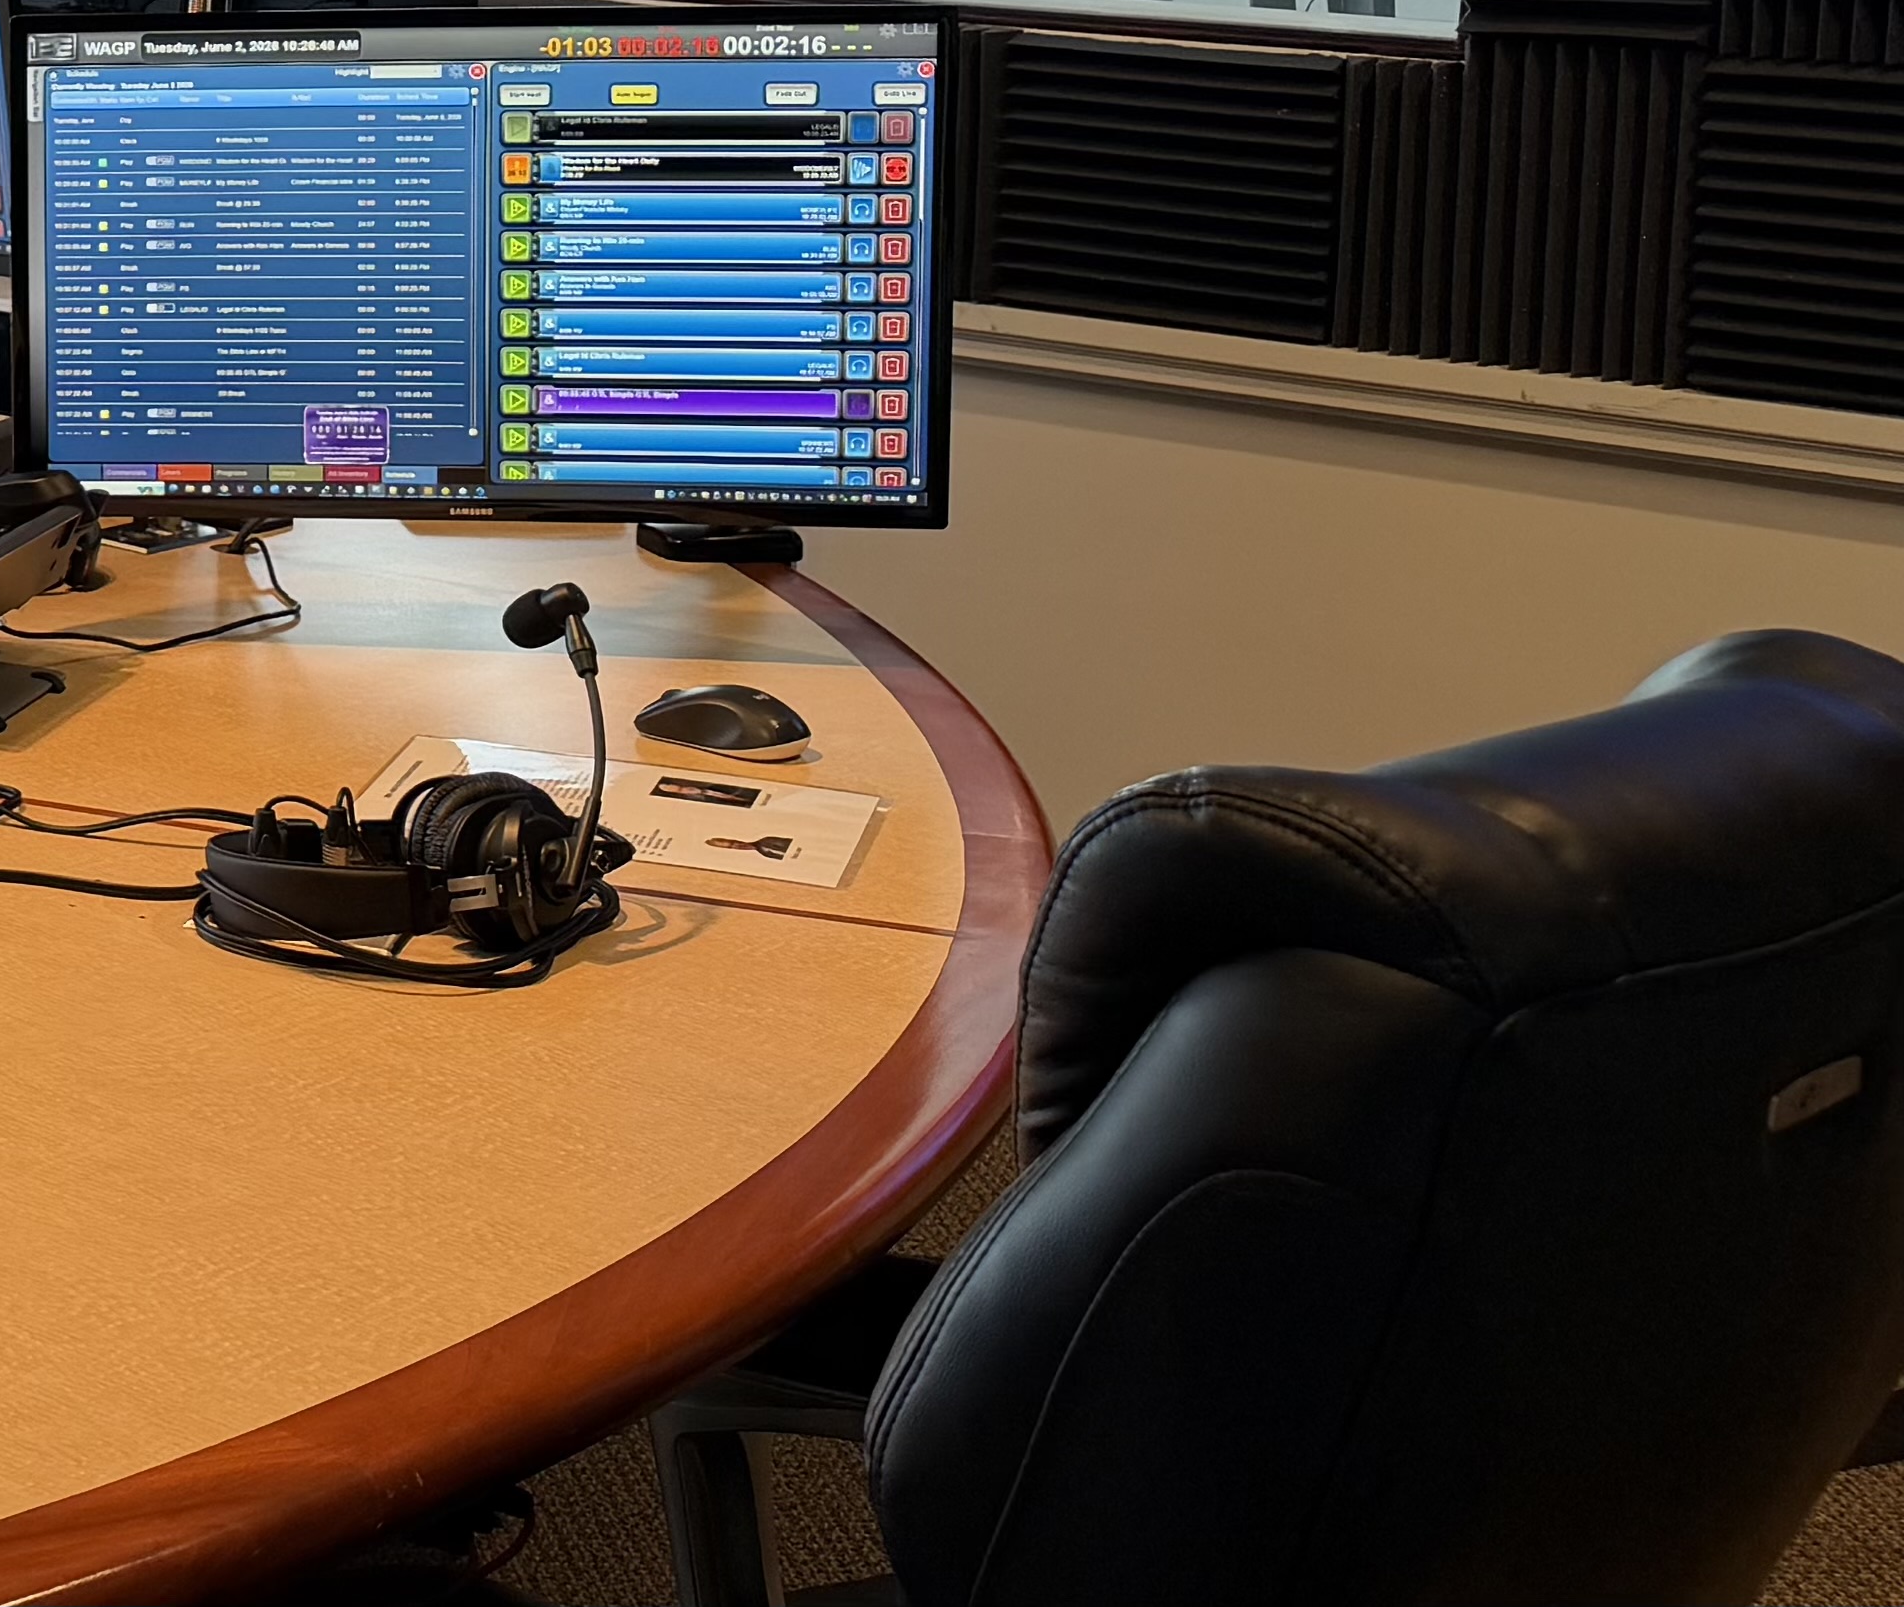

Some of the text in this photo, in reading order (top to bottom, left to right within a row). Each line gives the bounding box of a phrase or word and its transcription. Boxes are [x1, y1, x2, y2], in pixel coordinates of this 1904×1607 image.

[84, 41, 136, 56] WAGP
[143, 41, 199, 56] Tuesday,
[200, 41, 233, 53] June
[235, 40, 247, 55] 2,
[337, 39, 359, 51] AM
[539, 36, 612, 57] -01:03
[723, 34, 827, 56] 00:02:16
